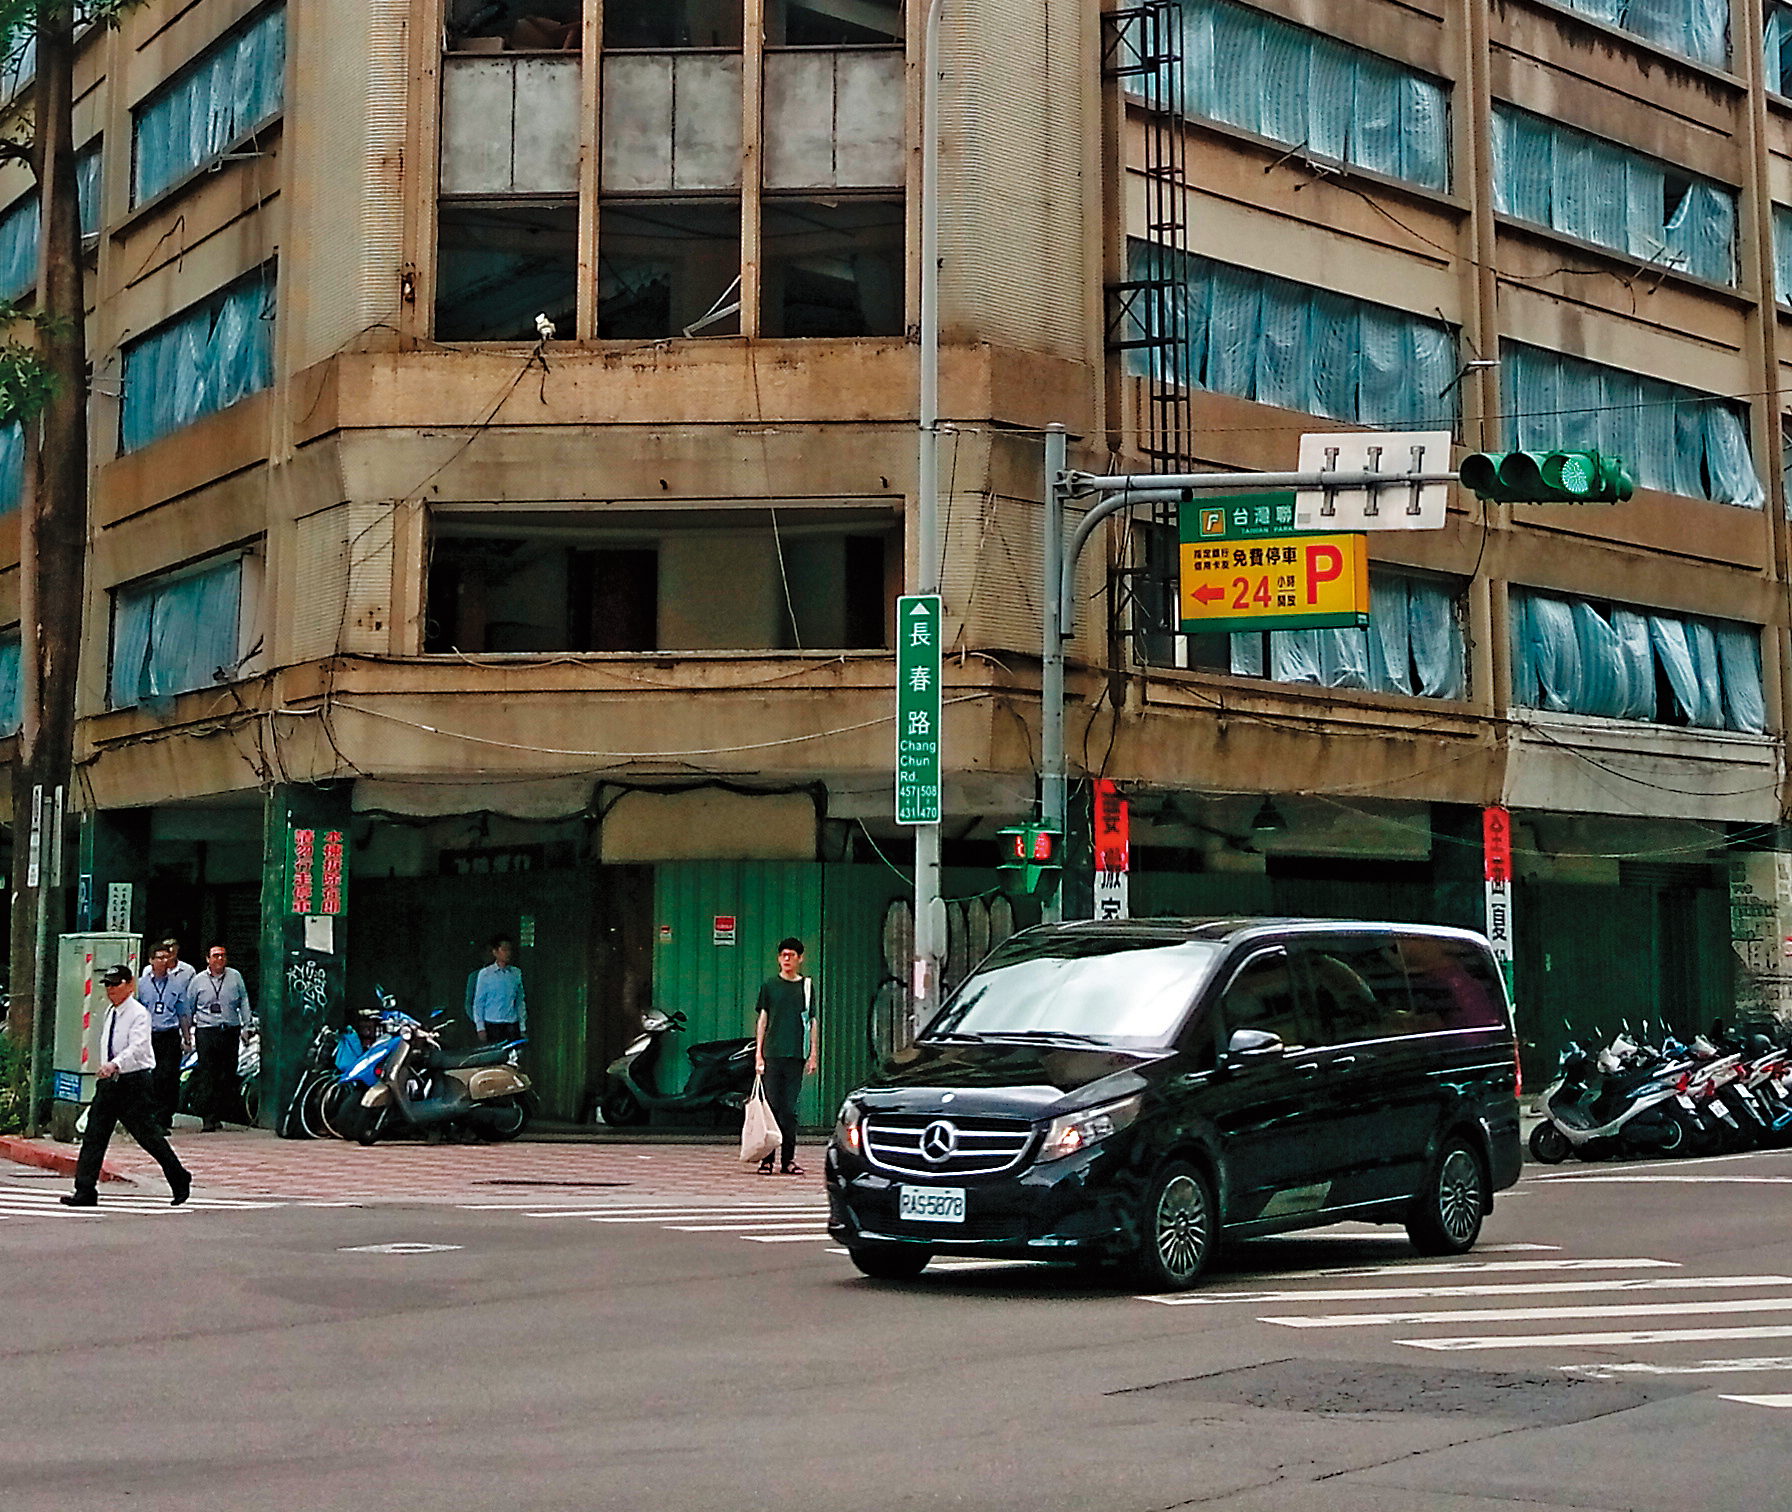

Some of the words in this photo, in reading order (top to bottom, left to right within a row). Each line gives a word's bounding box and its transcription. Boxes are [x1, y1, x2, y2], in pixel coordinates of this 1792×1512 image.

[1233, 546, 1298, 567] 免費停車
[1305, 543, 1344, 605] P
[1231, 575, 1273, 610] 24
[908, 621, 932, 736] 長春路
[900, 740, 937, 754] Chang
[900, 755, 930, 766] Chun
[900, 770, 919, 782] Rd.
